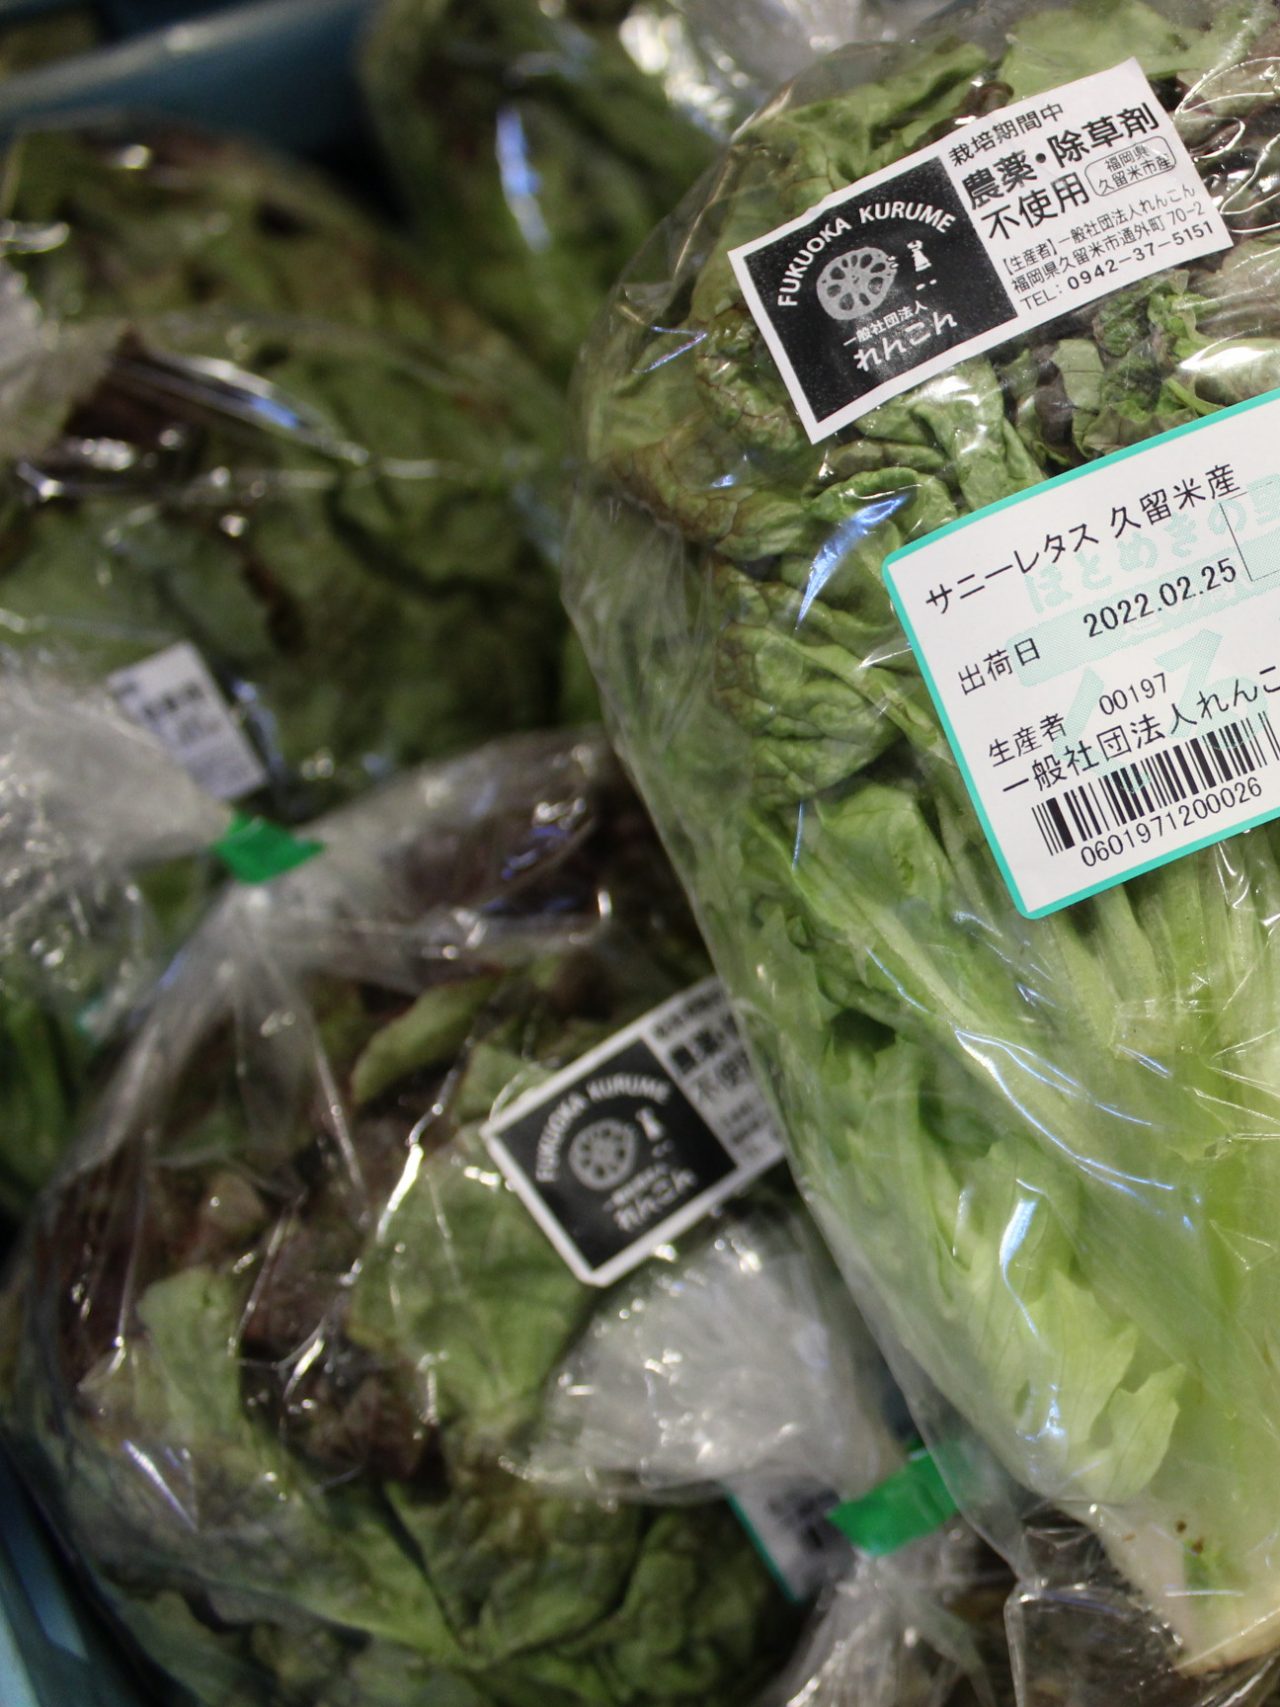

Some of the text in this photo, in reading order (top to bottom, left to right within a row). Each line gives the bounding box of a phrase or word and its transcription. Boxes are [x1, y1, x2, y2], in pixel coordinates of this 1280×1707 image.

[948, 103, 1064, 167] 栽培期間中
[961, 102, 1160, 210] 農薬・除草剤
[1099, 153, 1176, 194] 久留米市産
[1104, 143, 1149, 173] 福岡県
[981, 172, 1090, 240] 不使用
[1012, 201, 1206, 293] 福岡県久留米市通外町 70-2
[778, 201, 956, 307] FUKUOKA KURUME
[843, 301, 928, 346] 一般社団法人
[854, 312, 957, 371] れんこん
[926, 464, 1240, 614] サニーレタス 久留米産
[958, 558, 1237, 695] 出荷日 2022.02.25
[989, 673, 1168, 768] 生産者 00197
[1081, 777, 1263, 867] 0601971200026
